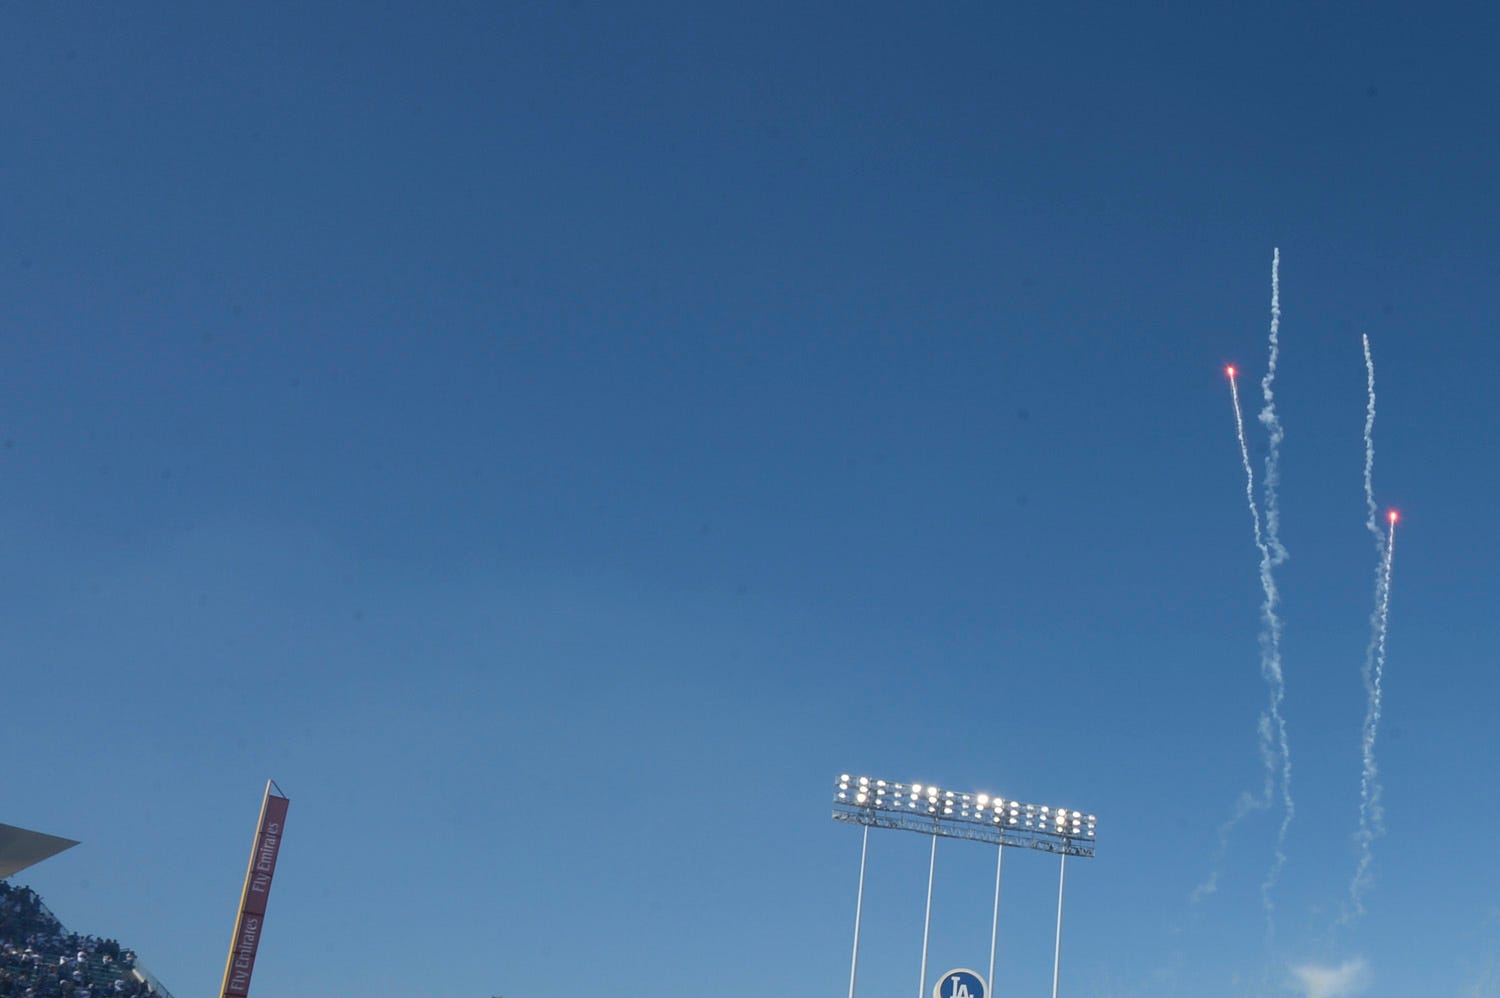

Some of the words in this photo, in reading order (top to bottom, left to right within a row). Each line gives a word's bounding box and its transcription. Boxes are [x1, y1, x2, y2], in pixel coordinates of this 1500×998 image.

[257, 822, 279, 871] Emirates
[252, 873, 272, 892] Fly
[235, 918, 258, 968] Emirates
[231, 970, 249, 990] Fly
